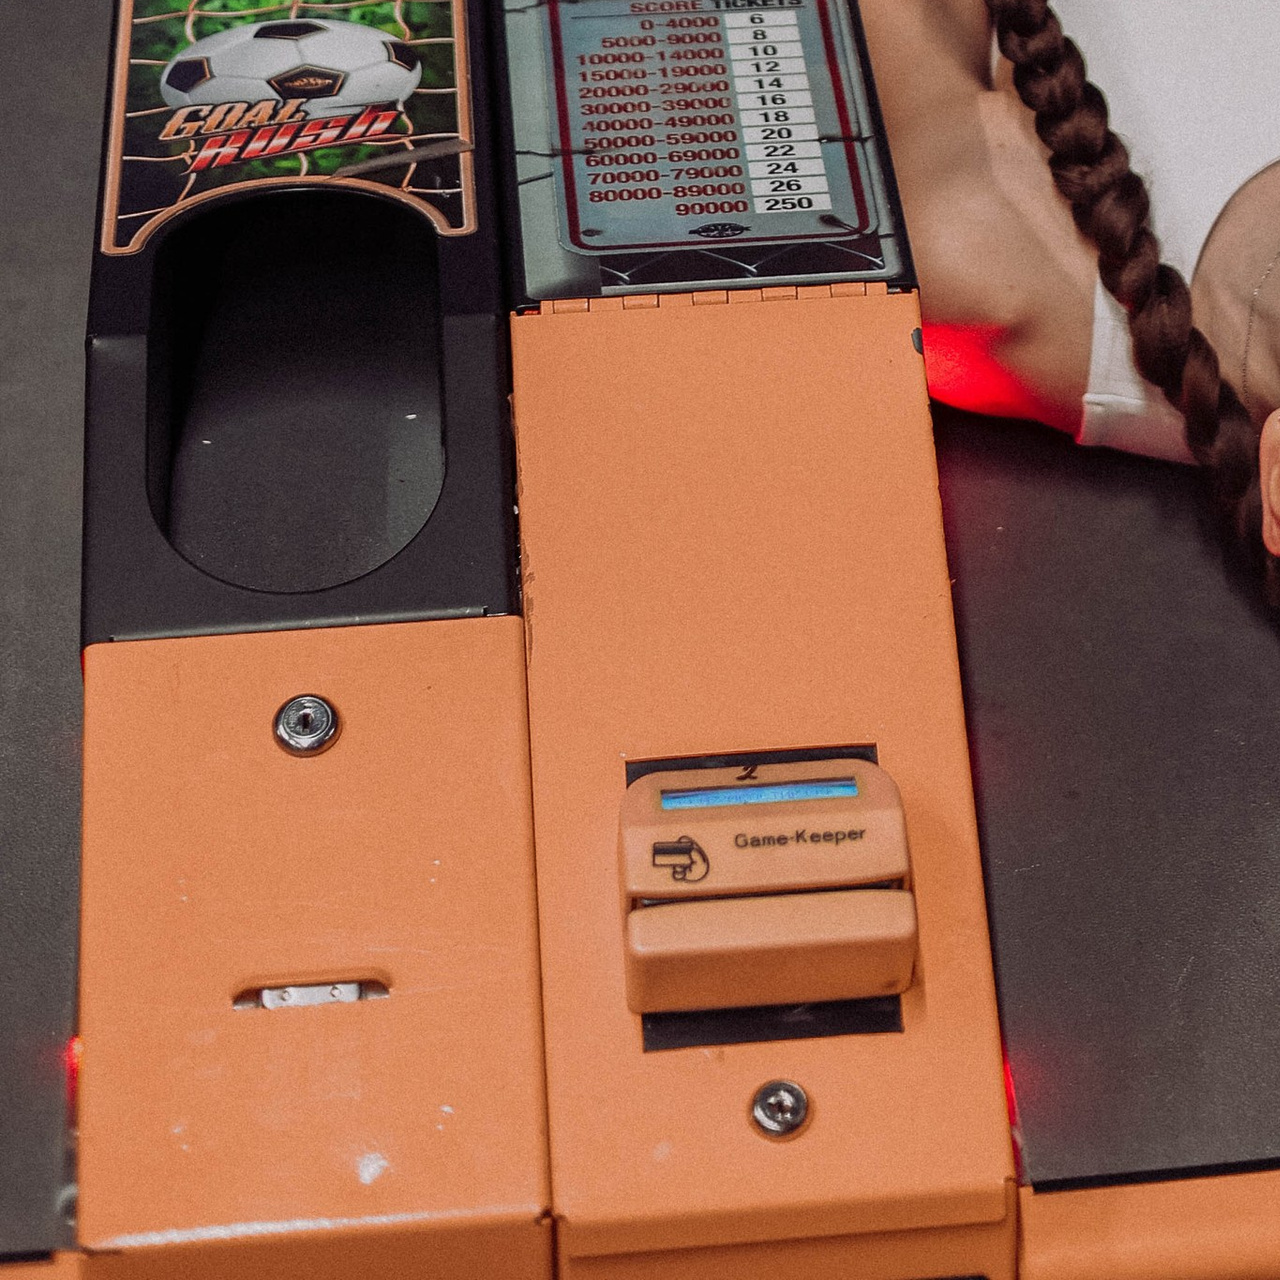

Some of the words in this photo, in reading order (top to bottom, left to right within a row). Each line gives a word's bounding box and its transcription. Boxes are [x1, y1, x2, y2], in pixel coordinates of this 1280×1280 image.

[630, 0, 702, 14] SCORE
[640, 16, 720, 31] 0-4000
[750, 13, 764, 25] 6
[601, 32, 722, 48] 5000-9000
[752, 29, 767, 40] 8
[576, 48, 724, 65] 10000-14000
[748, 45, 778, 56] 10
[578, 64, 727, 82] 15000-19000
[752, 61, 781, 73] 12
[579, 80, 730, 98] 20000-29000
[754, 77, 784, 89] 14
[580, 97, 732, 115] 30000-39000
[757, 94, 787, 106] 16
[159, 97, 309, 141] GOAL
[582, 113, 735, 132] 40000-49000
[759, 111, 790, 123] 18
[583, 130, 738, 149] 50000-59000
[761, 127, 793, 140] 20
[585, 147, 740, 167] 60000-69000
[764, 144, 797, 157] 22
[587, 165, 744, 185] 70000-79000
[767, 161, 799, 175] 24
[588, 182, 746, 202] 80000-89000
[769, 179, 802, 192] 26
[675, 200, 750, 216] 90000
[764, 197, 814, 211] 250
[735, 829, 866, 848] Game-Keeper
